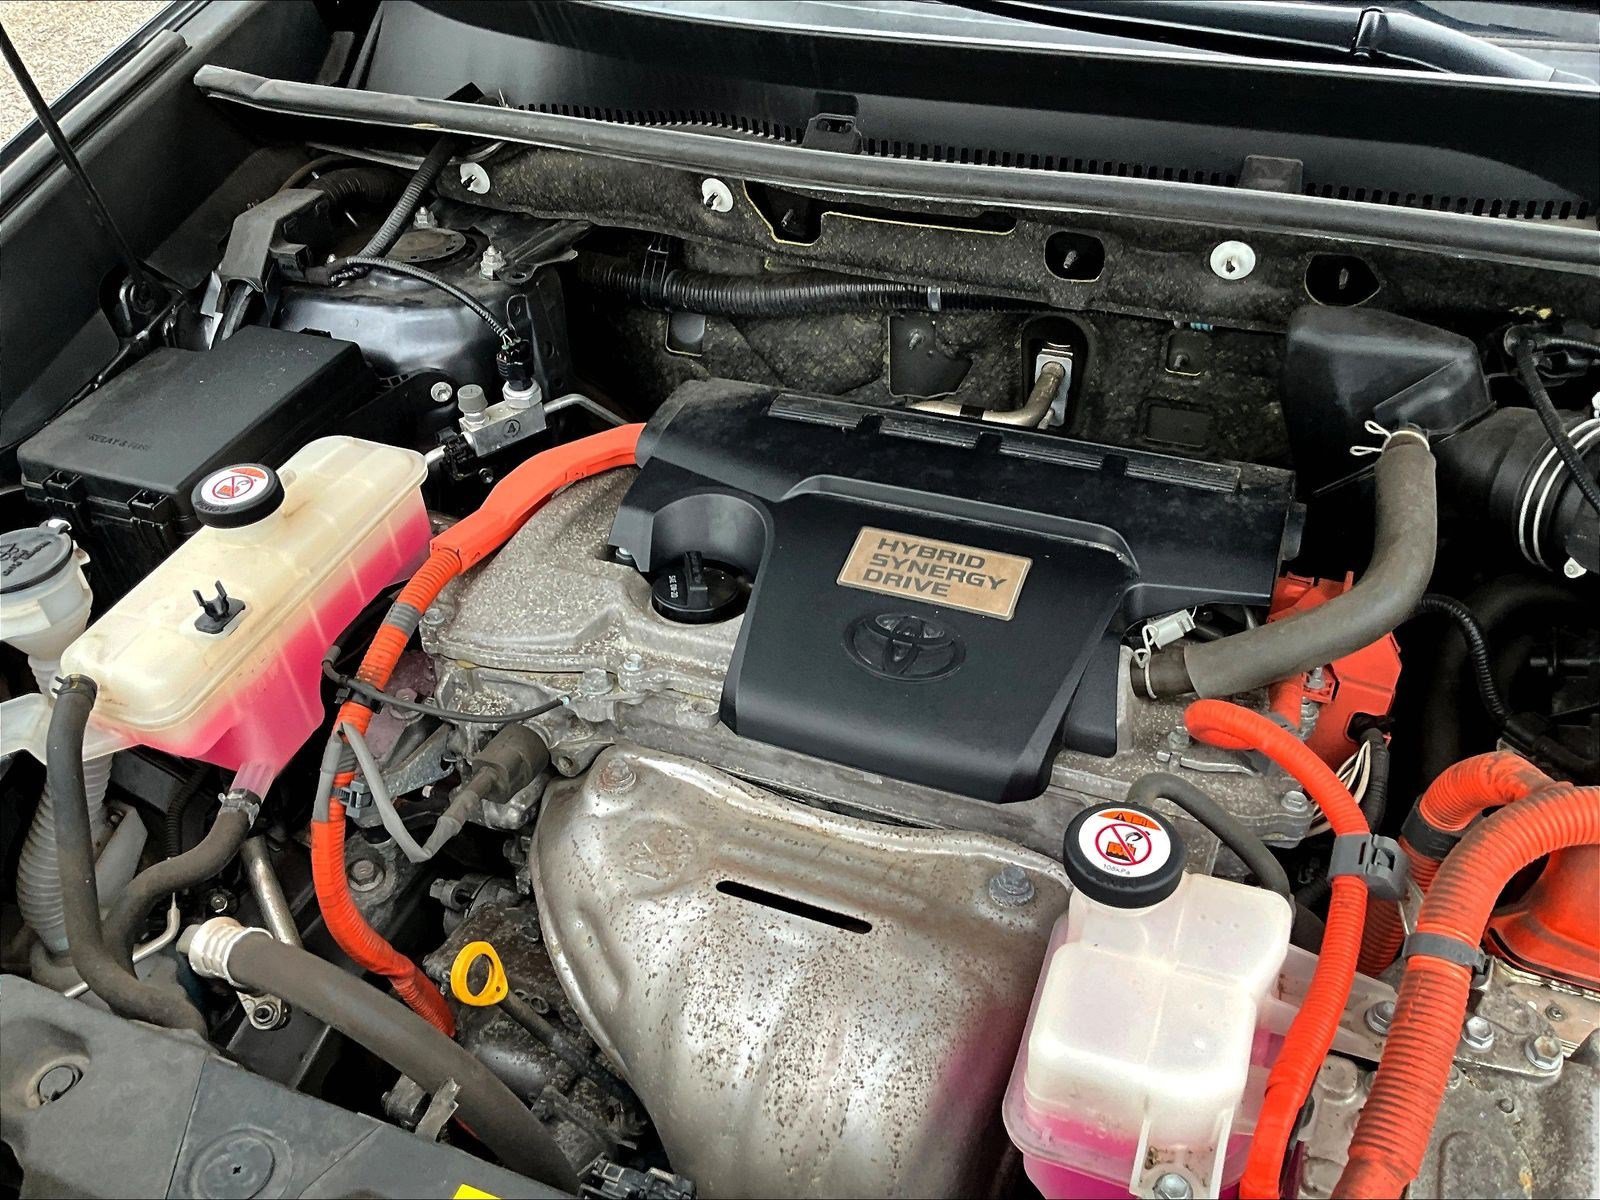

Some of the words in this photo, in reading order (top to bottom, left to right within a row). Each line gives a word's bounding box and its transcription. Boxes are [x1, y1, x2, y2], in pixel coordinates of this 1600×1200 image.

[87, 432, 120, 445] RELAY
[877, 537, 986, 569] HYBRID
[862, 568, 951, 598] DRIVE
[869, 552, 1008, 590] SYNERGY
